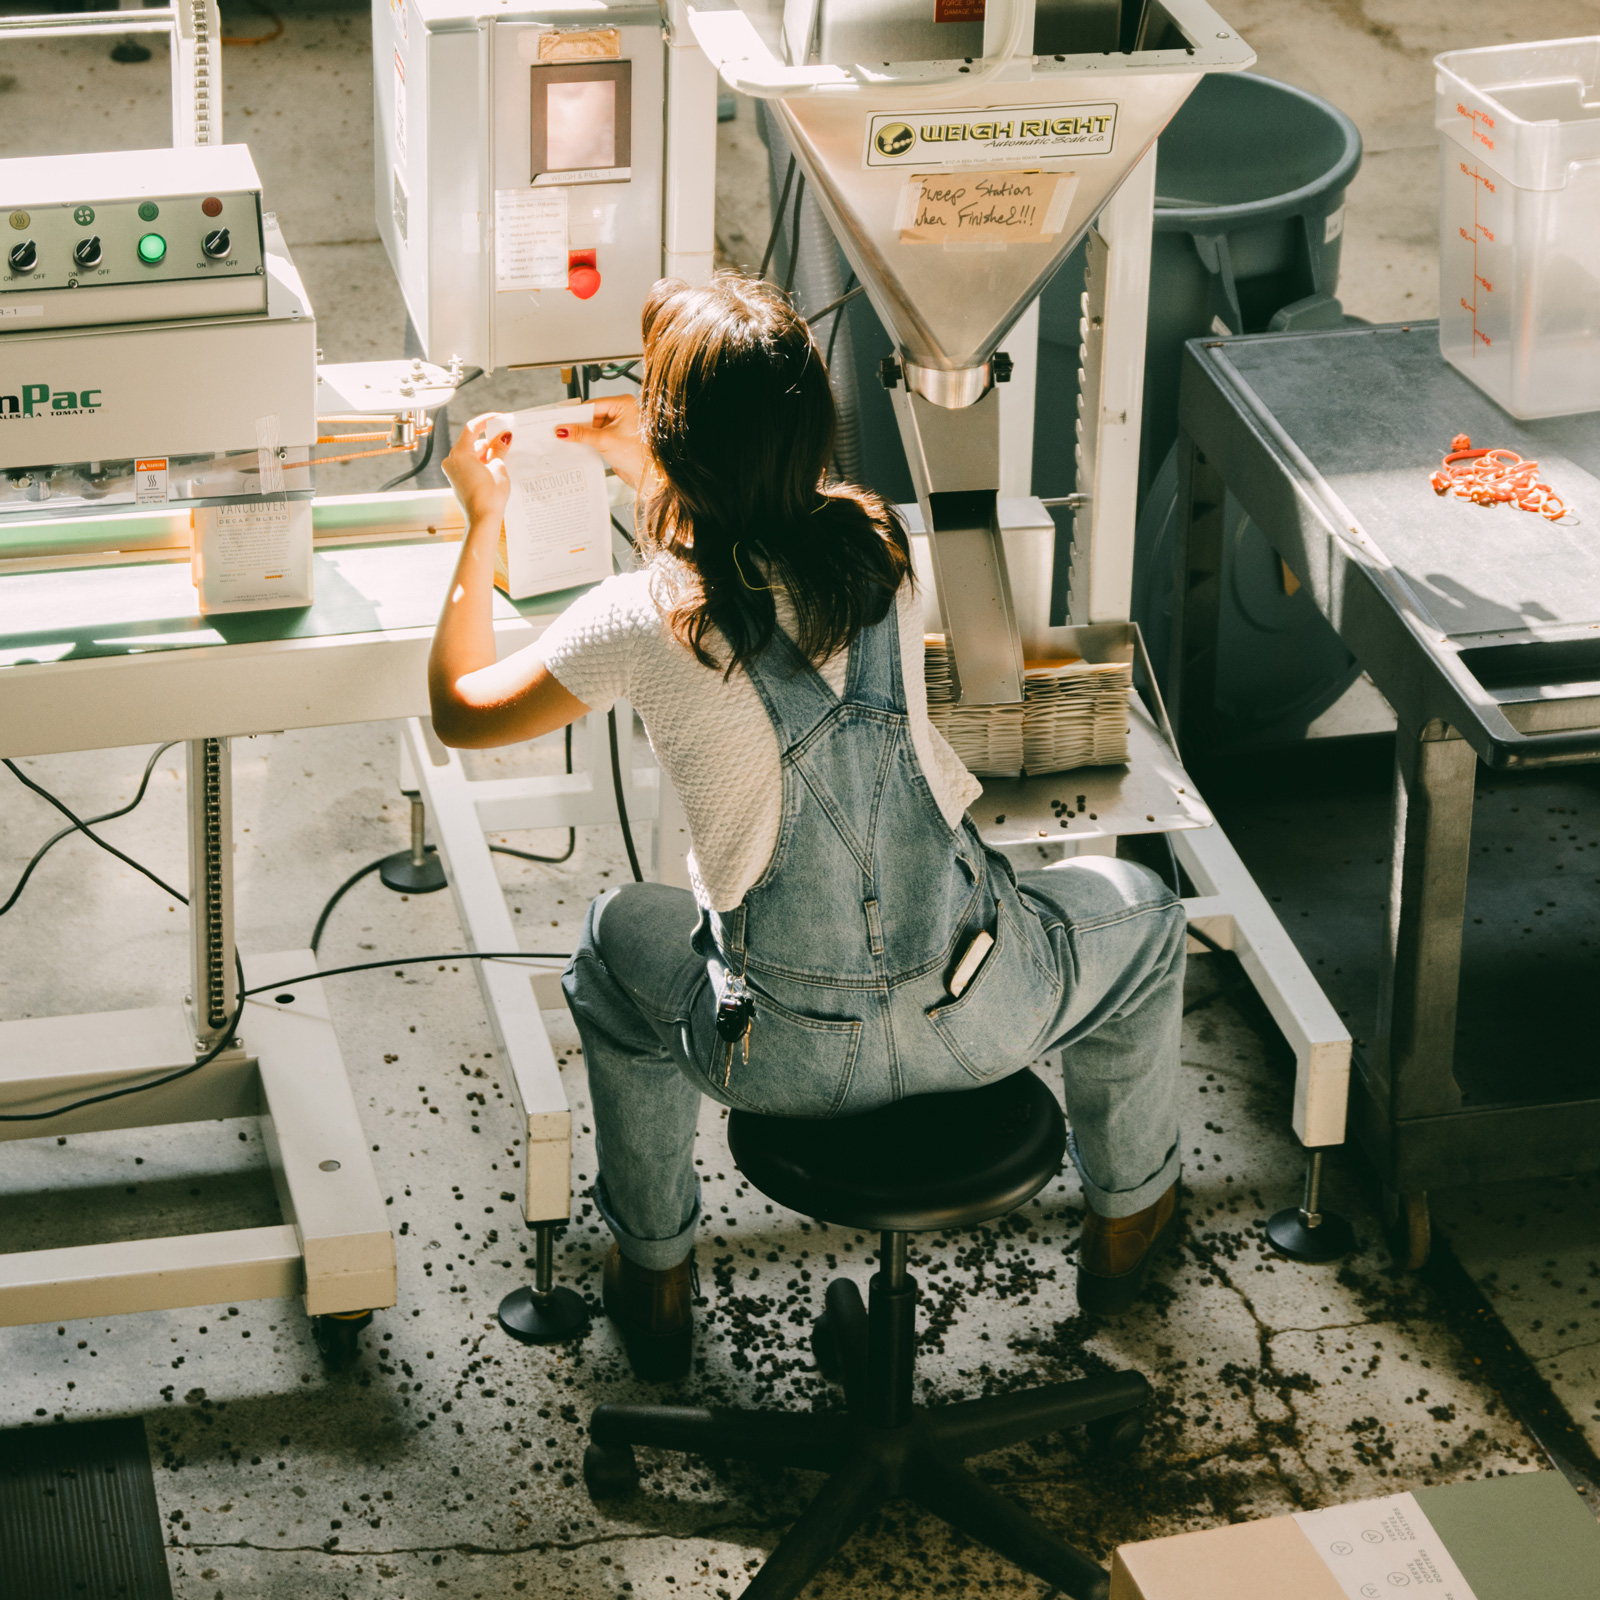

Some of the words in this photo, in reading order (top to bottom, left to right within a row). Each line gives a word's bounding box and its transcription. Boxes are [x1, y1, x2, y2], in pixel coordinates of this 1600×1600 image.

[943, 8, 970, 16] DAMAGE
[920, 121, 1015, 143] WEIGH
[1019, 115, 1112, 138] RIGHT
[983, 137, 1049, 148] Automatic
[1051, 135, 1087, 145] Scale
[1088, 134, 1105, 143] Co.
[550, 173, 576, 182] WEIGH
[577, 172, 583, 180] &
[584, 171, 599, 179] FILL
[919, 178, 966, 206] Sweep
[975, 178, 1033, 198] Station
[522, 470, 583, 494] VANCOUVER
[525, 494, 553, 504] DECAF
[557, 486, 586, 497] BLEND
[218, 517, 250, 525] DECAF
[1380, 1520, 1398, 1542] VERVE
[1387, 1516, 1407, 1541] COFFEE
[1392, 1507, 1417, 1540] ROASTERS
[1406, 1562, 1424, 1585] VERVE
[1413, 1557, 1434, 1584] COFFEE
[1418, 1549, 1444, 1583] ROASTERS
